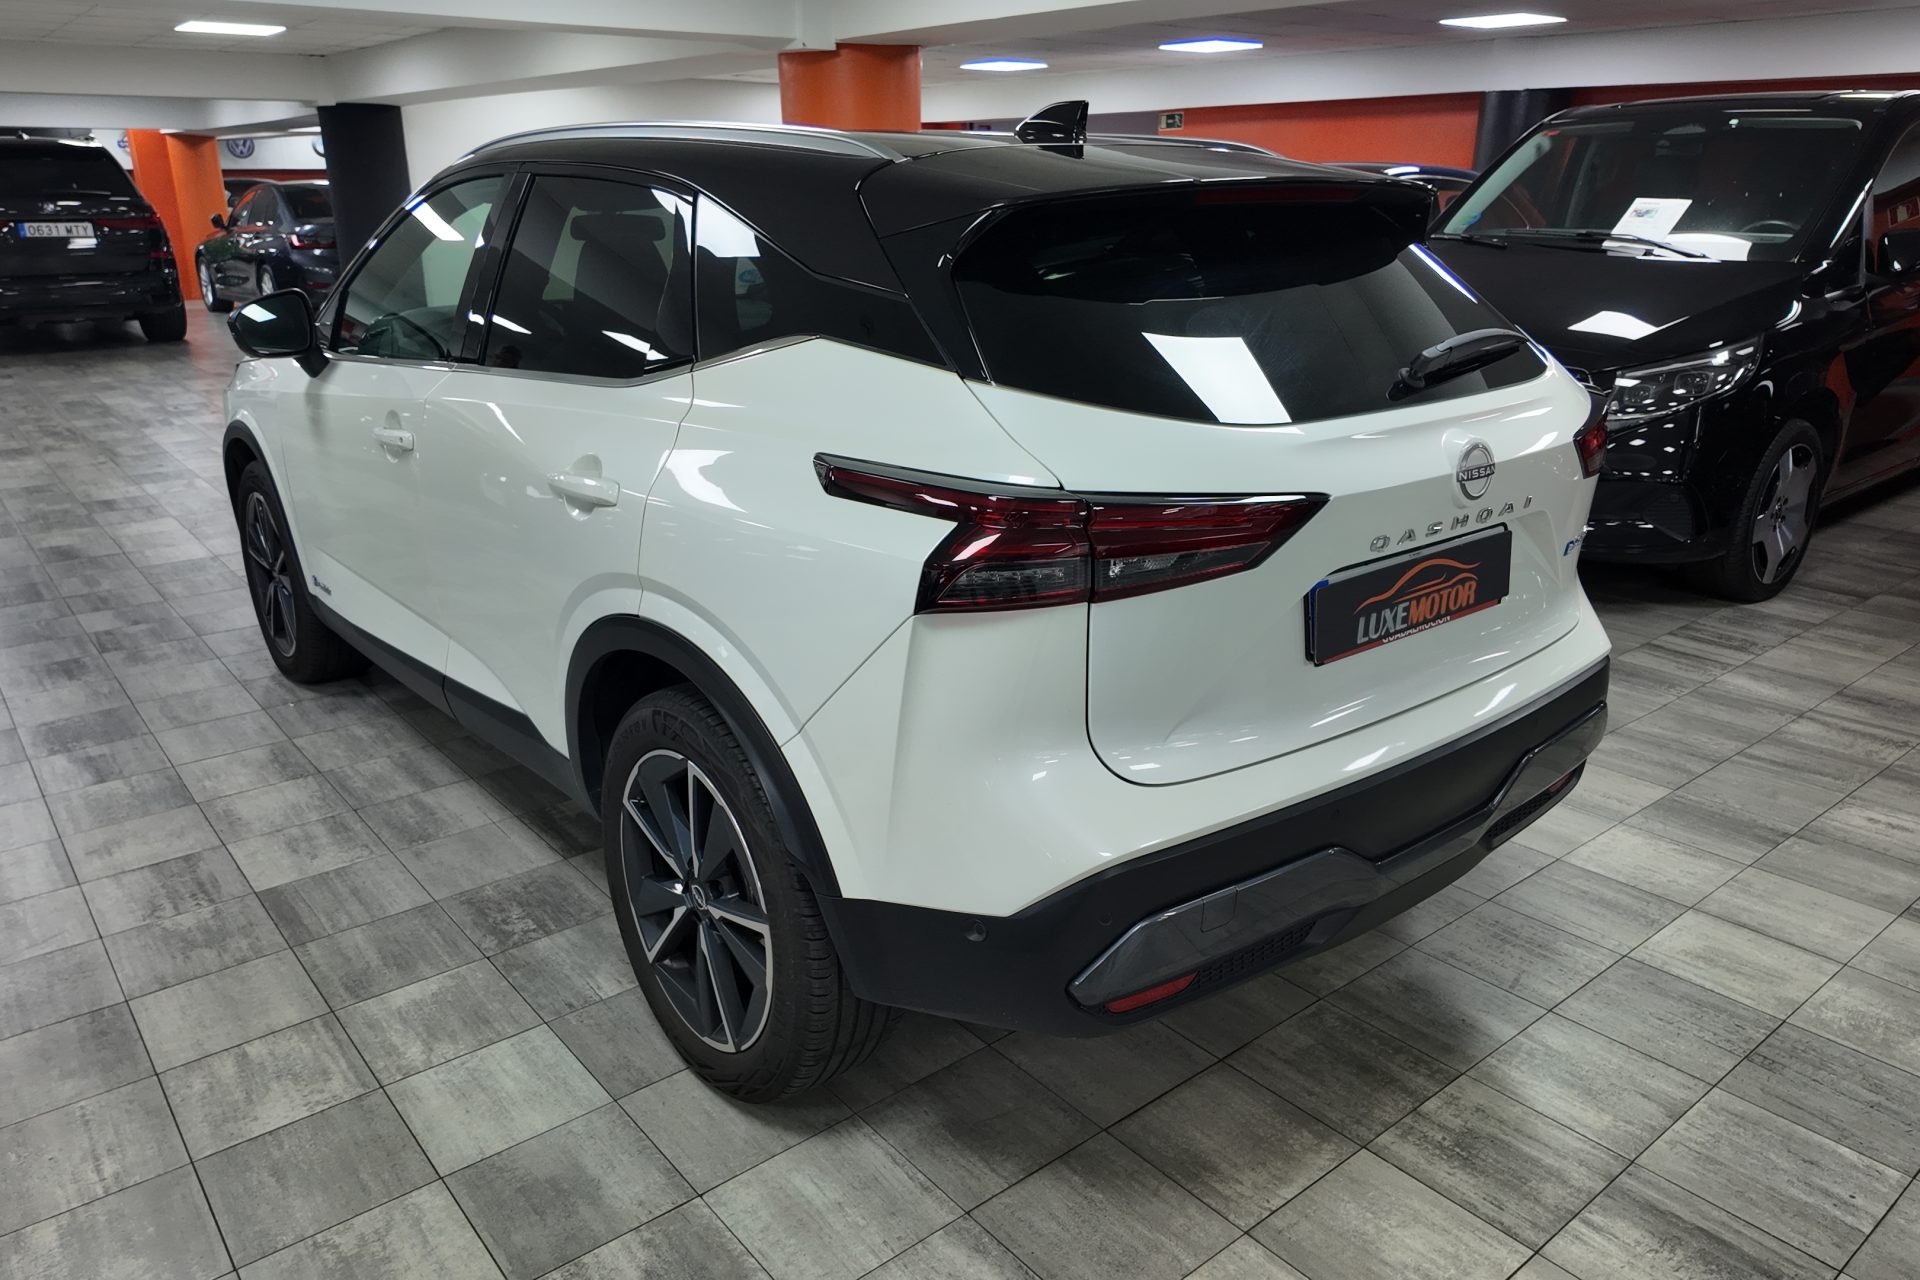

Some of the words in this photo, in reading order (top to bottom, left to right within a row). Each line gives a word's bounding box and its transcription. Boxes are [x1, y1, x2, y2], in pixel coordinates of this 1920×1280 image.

[28, 225, 60, 236] 0631
[65, 225, 89, 236] MTY
[1458, 465, 1495, 481] NISSAN
[1369, 495, 1533, 552] QASHQAI
